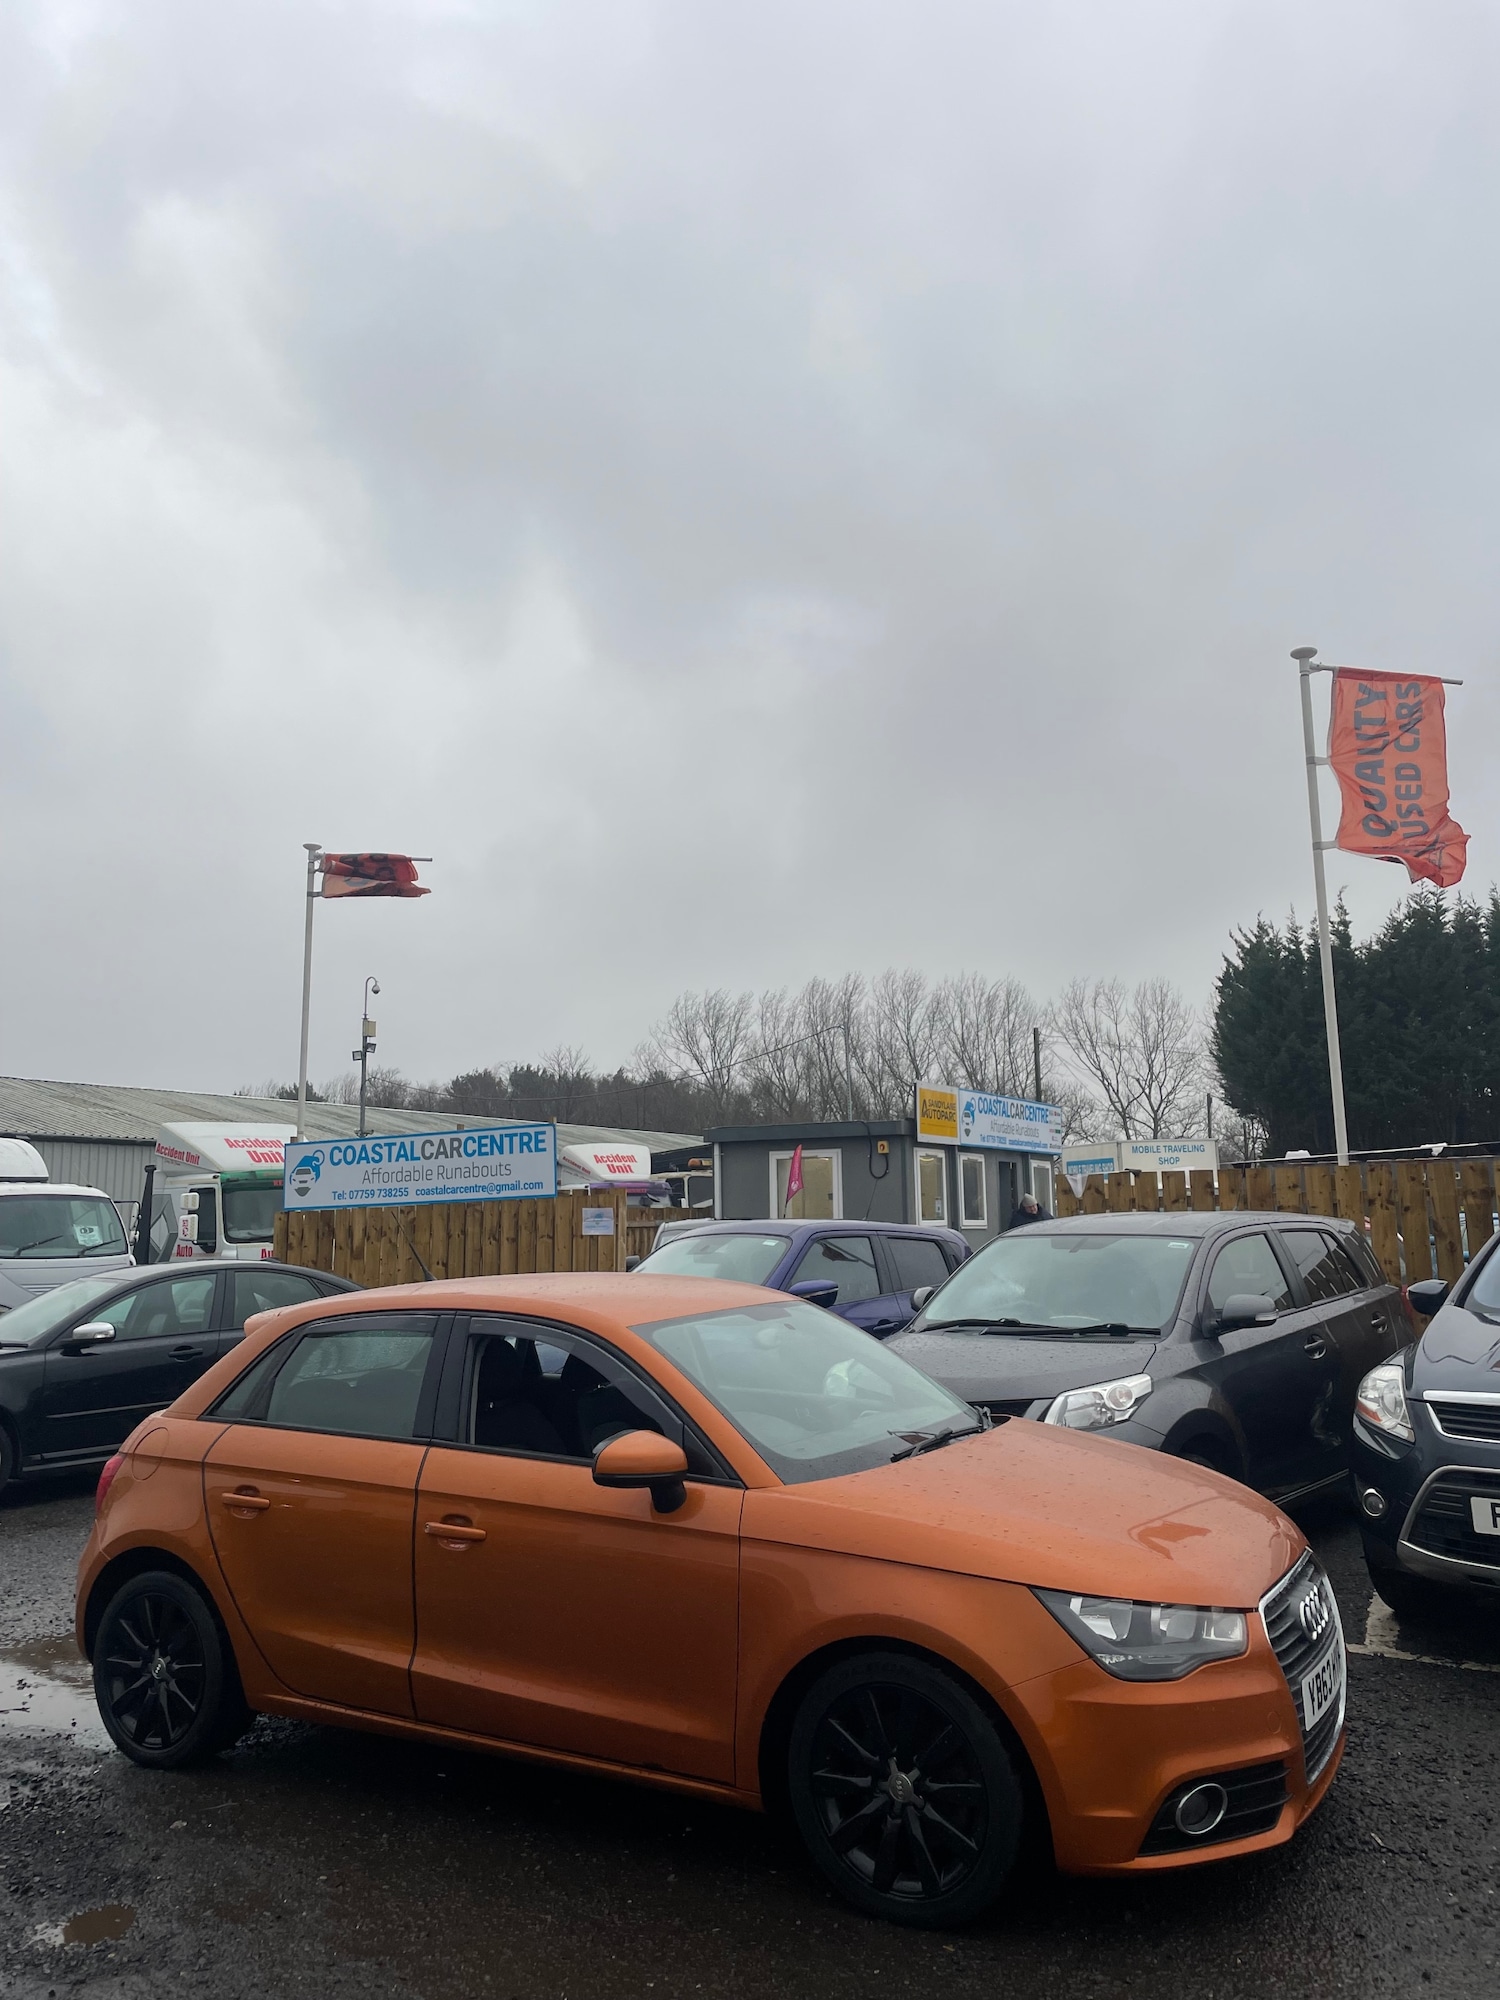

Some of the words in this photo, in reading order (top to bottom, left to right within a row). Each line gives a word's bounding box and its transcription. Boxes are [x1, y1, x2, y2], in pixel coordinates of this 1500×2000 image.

[1354, 682, 1398, 838] QUALITY
[1394, 763, 1431, 838] USED
[977, 1096, 1049, 1124] COASTALCARCENTRE
[155, 1143, 186, 1162] Accident
[185, 1151, 201, 1166] Unit
[329, 1130, 548, 1167] COASTALCARCENTRE
[593, 1153, 638, 1164] Accident
[1131, 1145, 1162, 1154] MOBILE
[1163, 1144, 1206, 1153] TRAVELING
[606, 1163, 635, 1174] Unit
[1158, 1156, 1181, 1165] SHOP
[361, 1165, 433, 1185] Affordable
[436, 1161, 512, 1180] Runabouts
[331, 1190, 348, 1201] Tel:
[348, 1189, 376, 1200] 07759
[376, 1187, 409, 1198] 738255
[415, 1180, 544, 1197] coastalcarcentre@gmail.com
[176, 1244, 193, 1257] Auto
